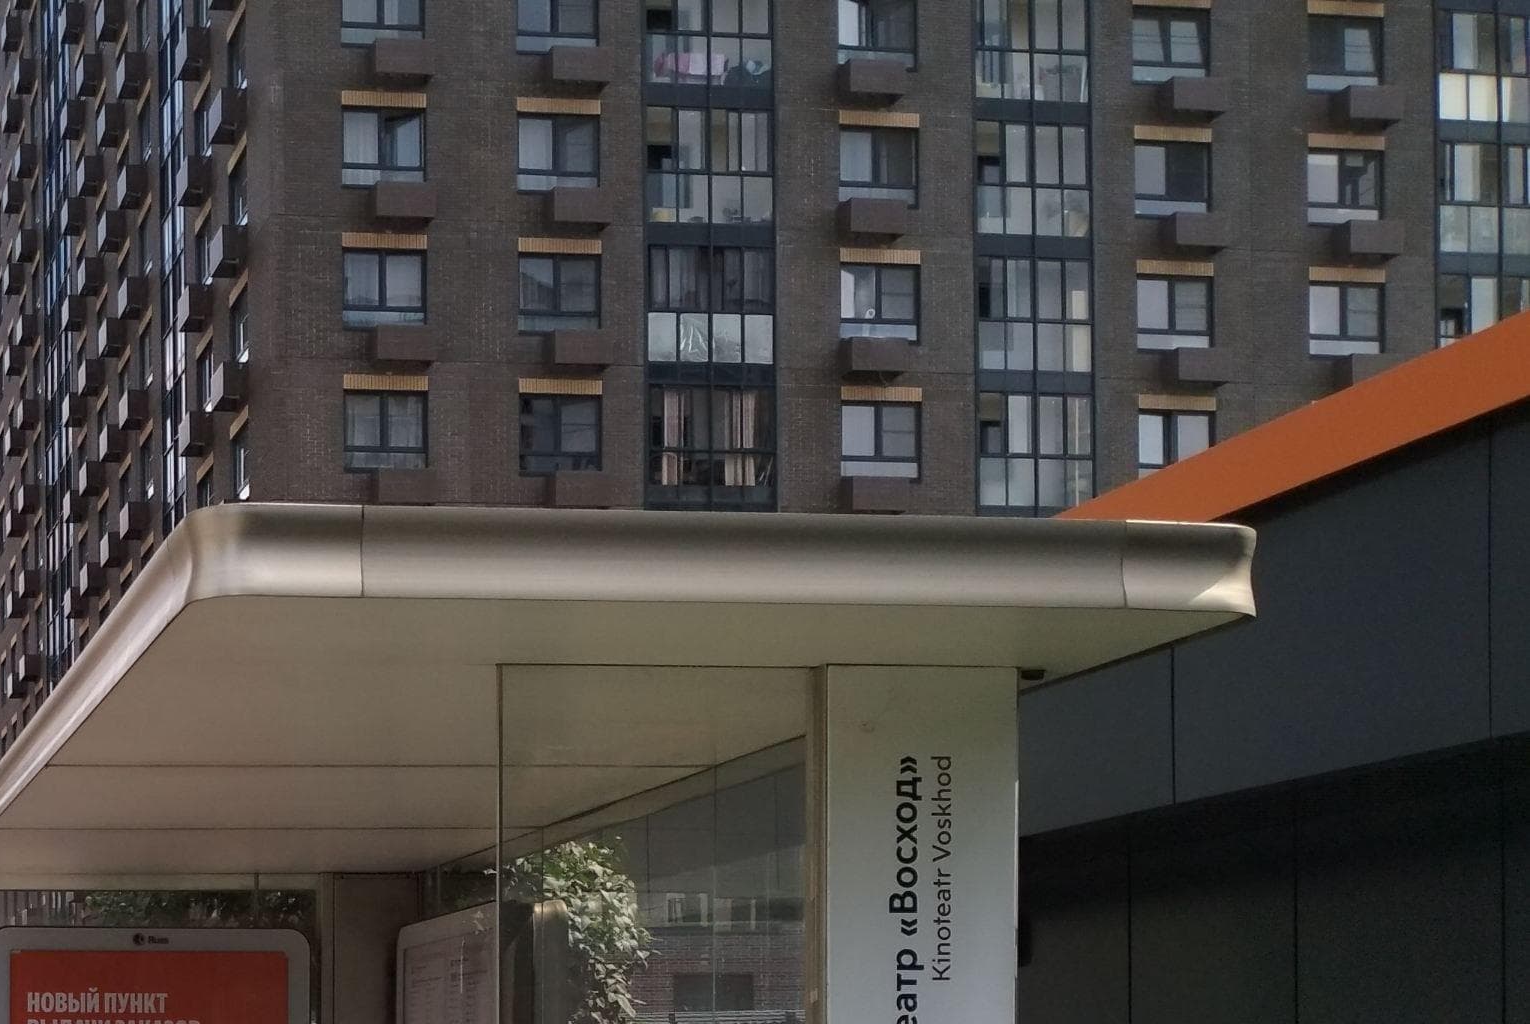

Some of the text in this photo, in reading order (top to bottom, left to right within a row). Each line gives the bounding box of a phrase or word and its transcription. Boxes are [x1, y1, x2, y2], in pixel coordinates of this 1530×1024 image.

[888, 755, 923, 937] «Восход»
[930, 755, 952, 982] Kinoteatr Voskhod
[26, 987, 168, 1014] НОВЫЙ ПУНКТ
